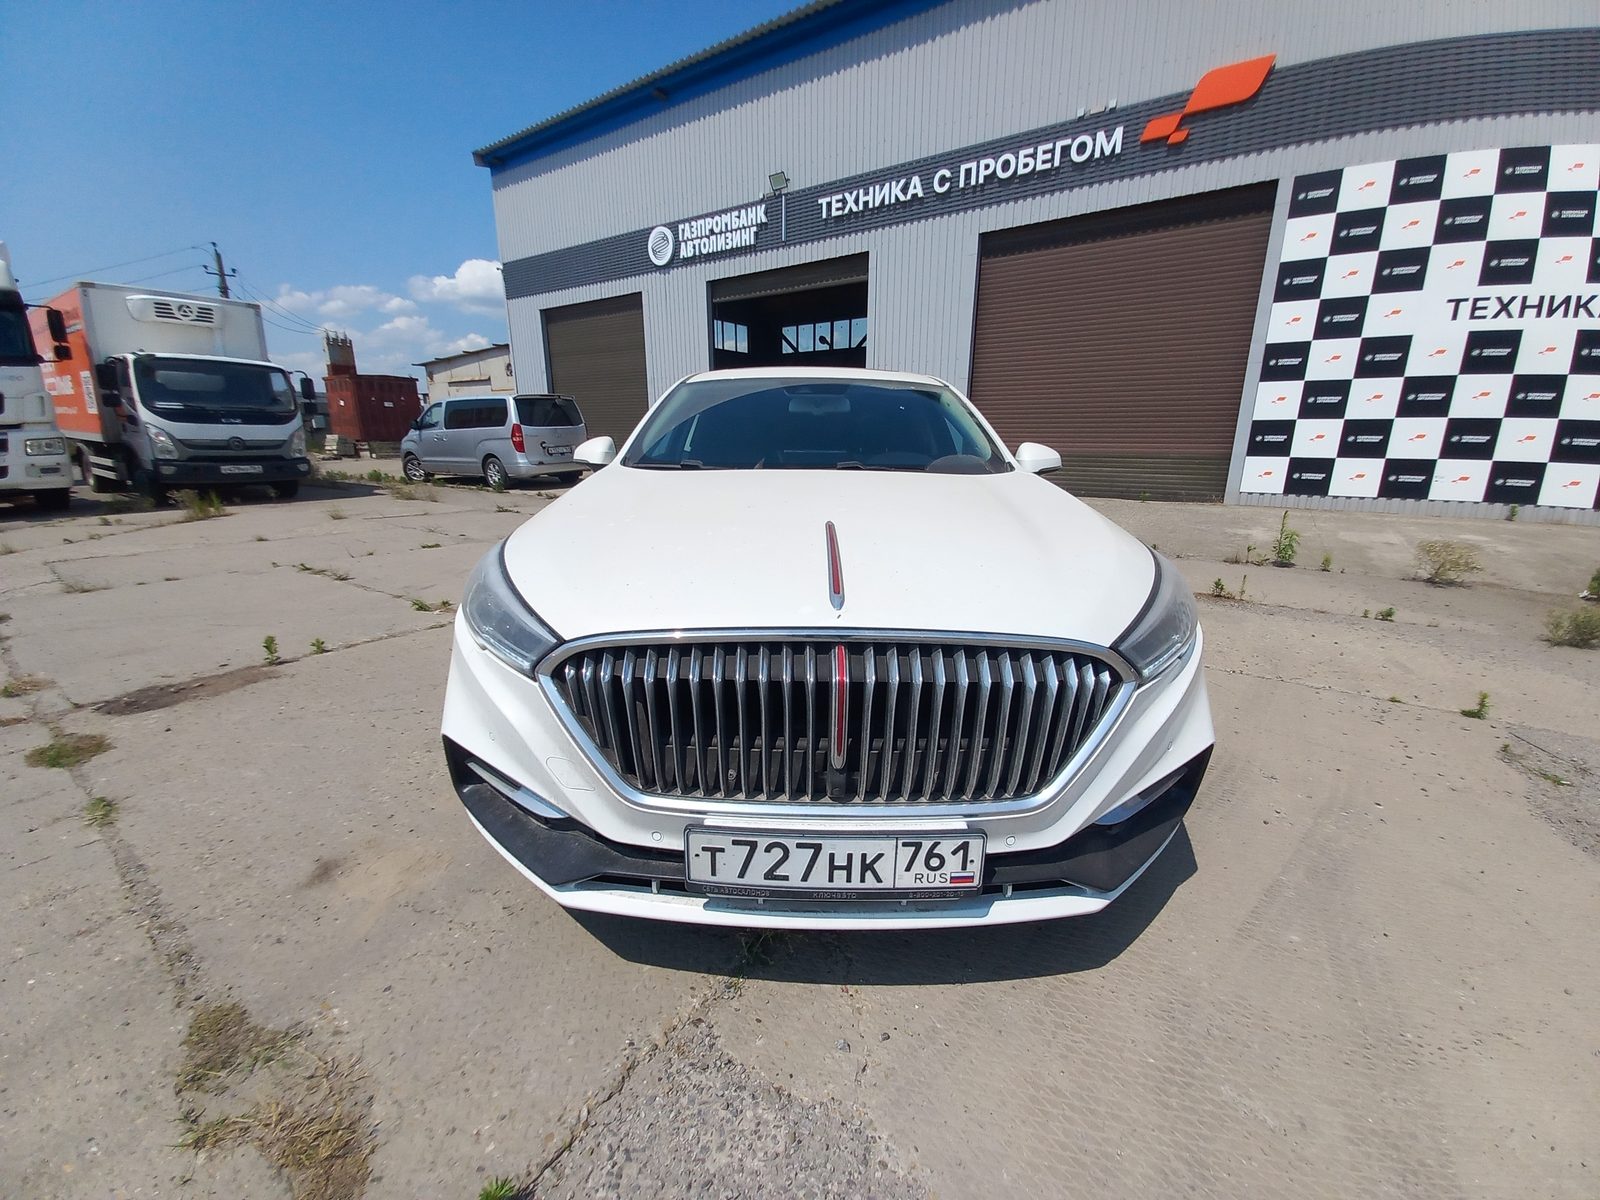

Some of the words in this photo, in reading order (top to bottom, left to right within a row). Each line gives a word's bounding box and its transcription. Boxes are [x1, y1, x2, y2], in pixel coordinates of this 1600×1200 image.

[818, 175, 924, 219] ТЕХНИКА
[933, 168, 952, 193] С
[959, 126, 1124, 188] ПРОБЕГОМ
[678, 204, 768, 241] ГАЗПРОМБАНК
[680, 226, 757, 259] АВТОЛИЗИНГ
[1446, 294, 1600, 321] ТЕХНИК
[701, 839, 885, 884] Т727НК
[902, 841, 971, 872] 761
[914, 873, 948, 884] RUS
